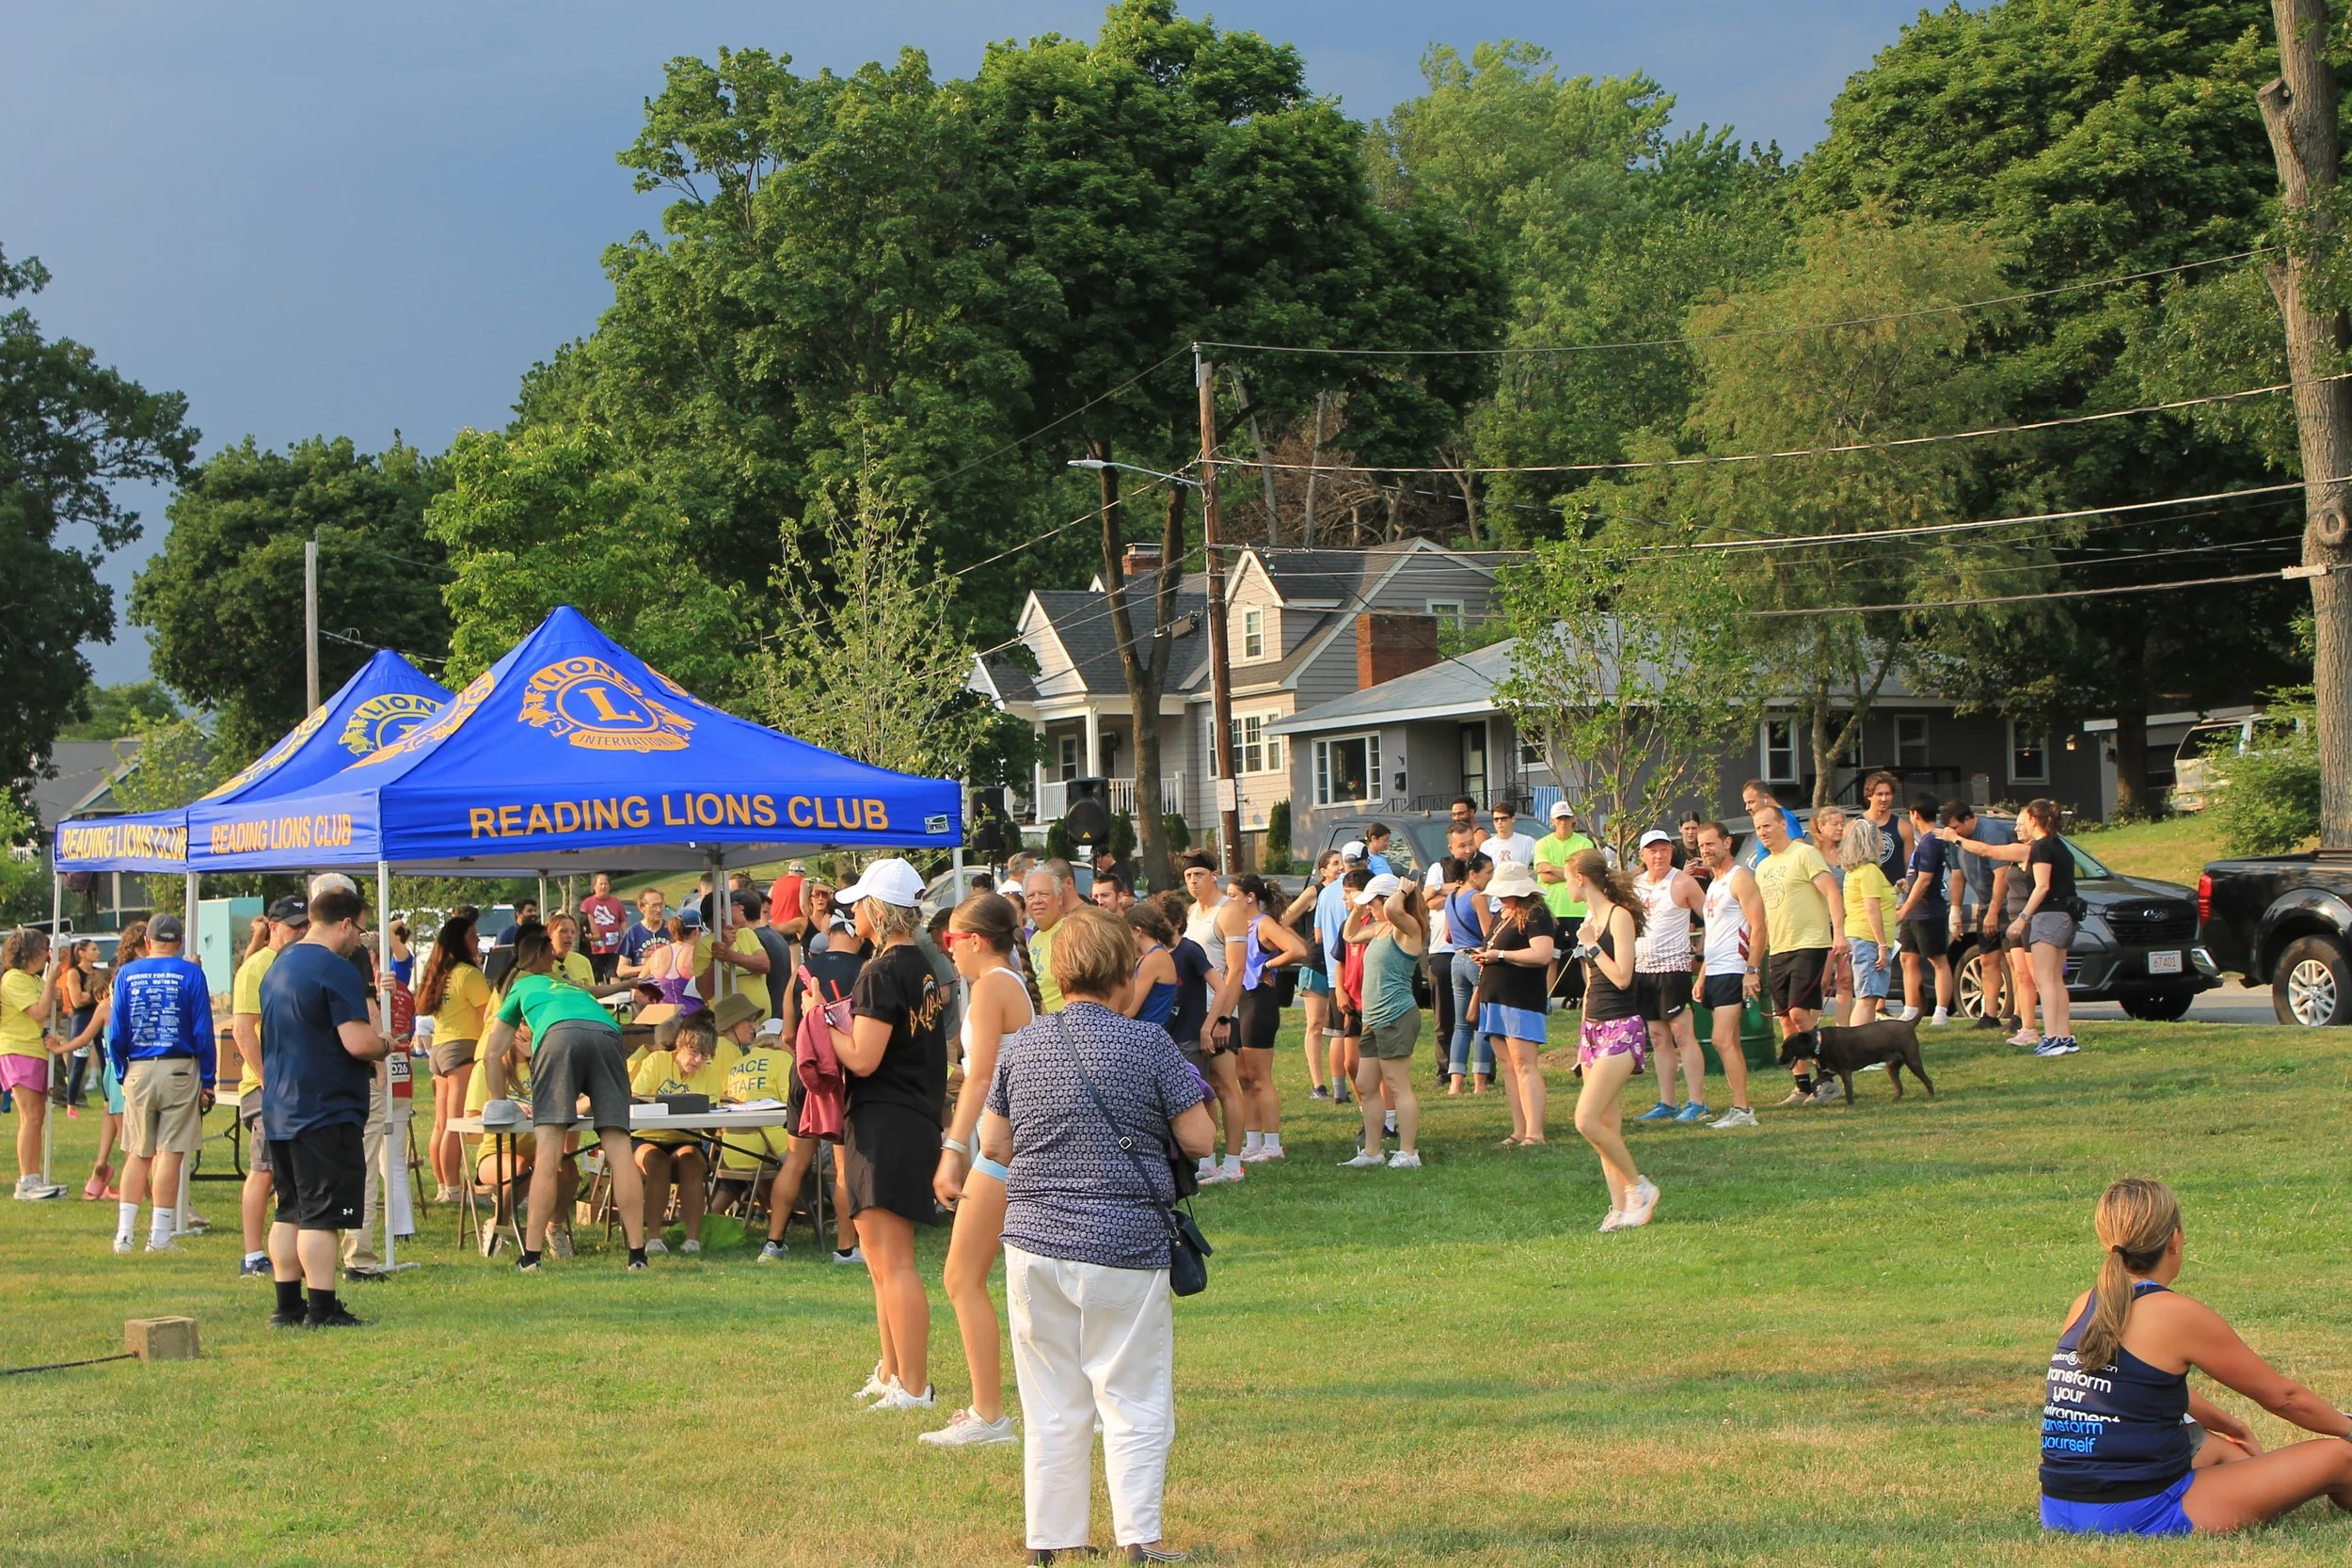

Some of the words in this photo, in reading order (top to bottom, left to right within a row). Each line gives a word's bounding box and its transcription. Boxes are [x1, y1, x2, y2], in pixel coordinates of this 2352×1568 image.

[536, 660, 642, 695] LIONS
[364, 696, 437, 717] LION
[579, 687, 644, 722] L
[580, 734, 681, 747] INTERNATIONAL
[469, 796, 651, 839] READING
[662, 793, 777, 827] LIONS
[787, 796, 889, 830] CLUB
[61, 826, 113, 859] READING
[115, 824, 154, 859] LIONS
[154, 826, 187, 861] CLUB
[210, 819, 269, 854] READING
[271, 815, 311, 850] LIONS
[314, 814, 353, 847] CLUB
[643, 937, 670, 949] COMPOS
[730, 1058, 769, 1077] RACE
[733, 1076, 766, 1094] TAFF
[2046, 1367, 2112, 1393] ransform
[2053, 1386, 2086, 1403] your
[2042, 1436, 2096, 1453] yourself
